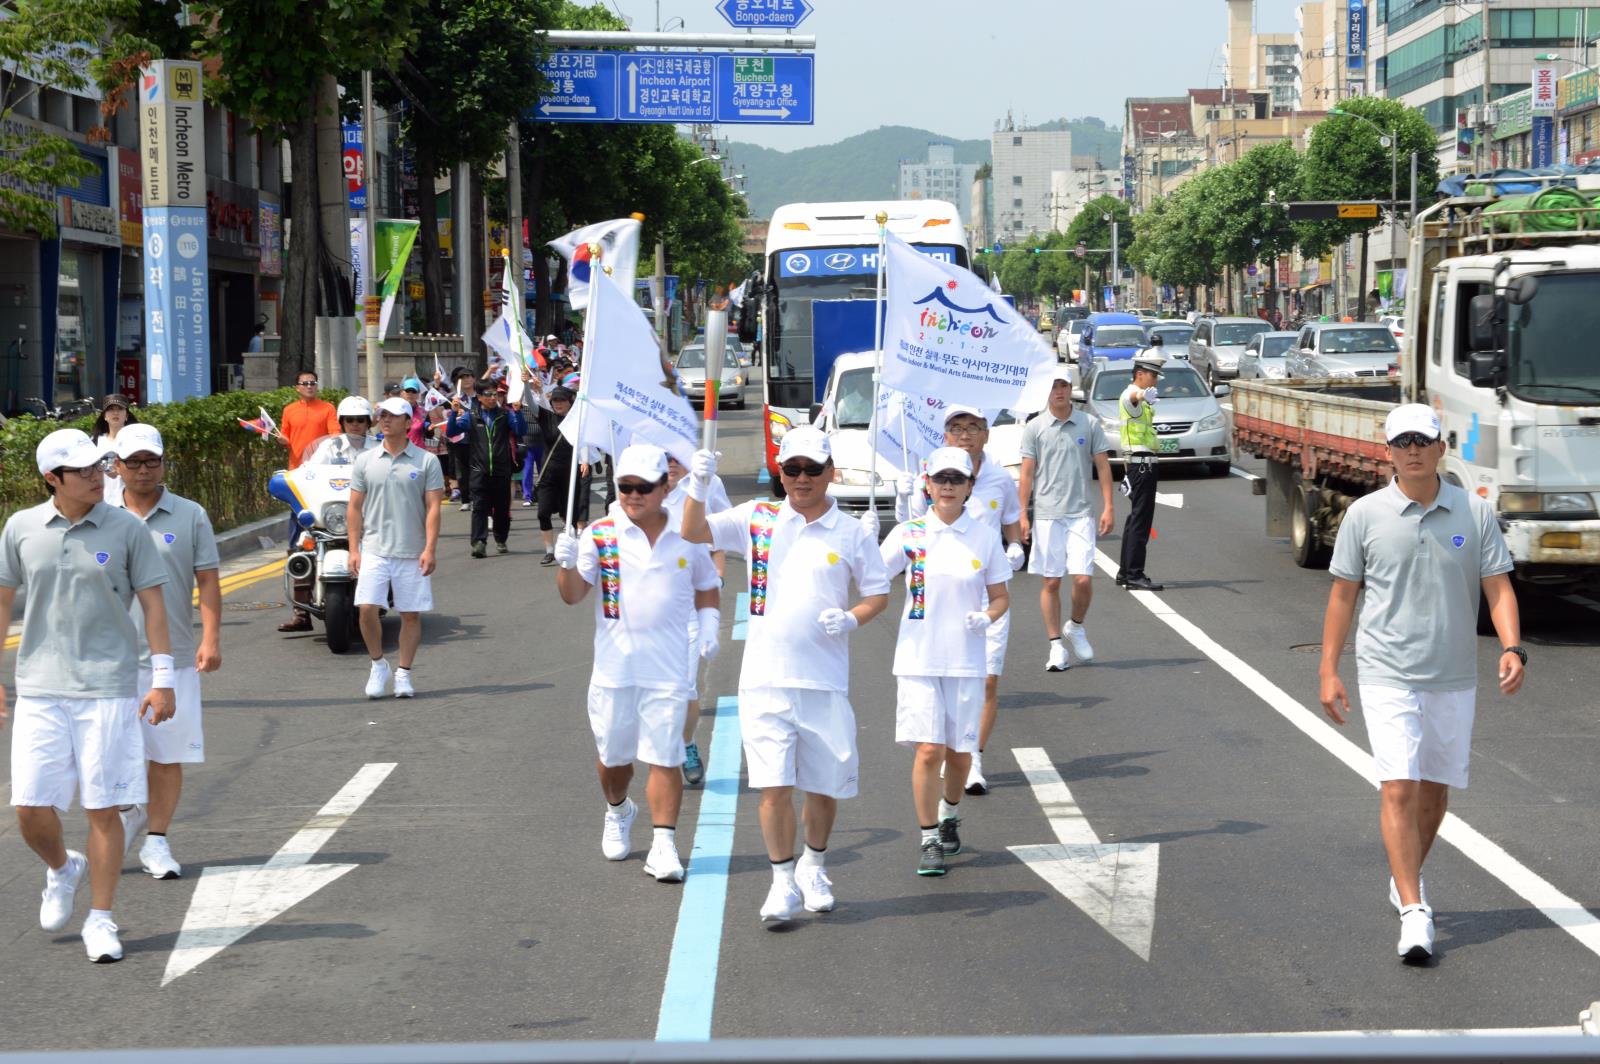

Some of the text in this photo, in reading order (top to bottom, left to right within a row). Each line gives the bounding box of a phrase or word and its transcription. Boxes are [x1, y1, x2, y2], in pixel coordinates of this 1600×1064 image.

[736, 11, 795, 24] Bongo-daero
[656, 58, 711, 74] 인천국제공항
[736, 56, 764, 72] 부천
[180, 72, 188, 82] M
[640, 76, 710, 88] Incheon Airport
[735, 72, 774, 82] Bucheon
[640, 88, 712, 104] 경인교육대학교
[733, 83, 793, 98] 계양구청
[733, 97, 798, 108] Gyeyang-gu Office
[148, 106, 160, 201] 인천메트로
[175, 106, 194, 200] Incheon Metro
[190, 267, 204, 334] Jakjeon
[962, 358, 1029, 378] 아시아경기대회
[948, 368, 961, 378] Arts
[962, 371, 984, 382] Games
[984, 375, 1011, 385] Incheon
